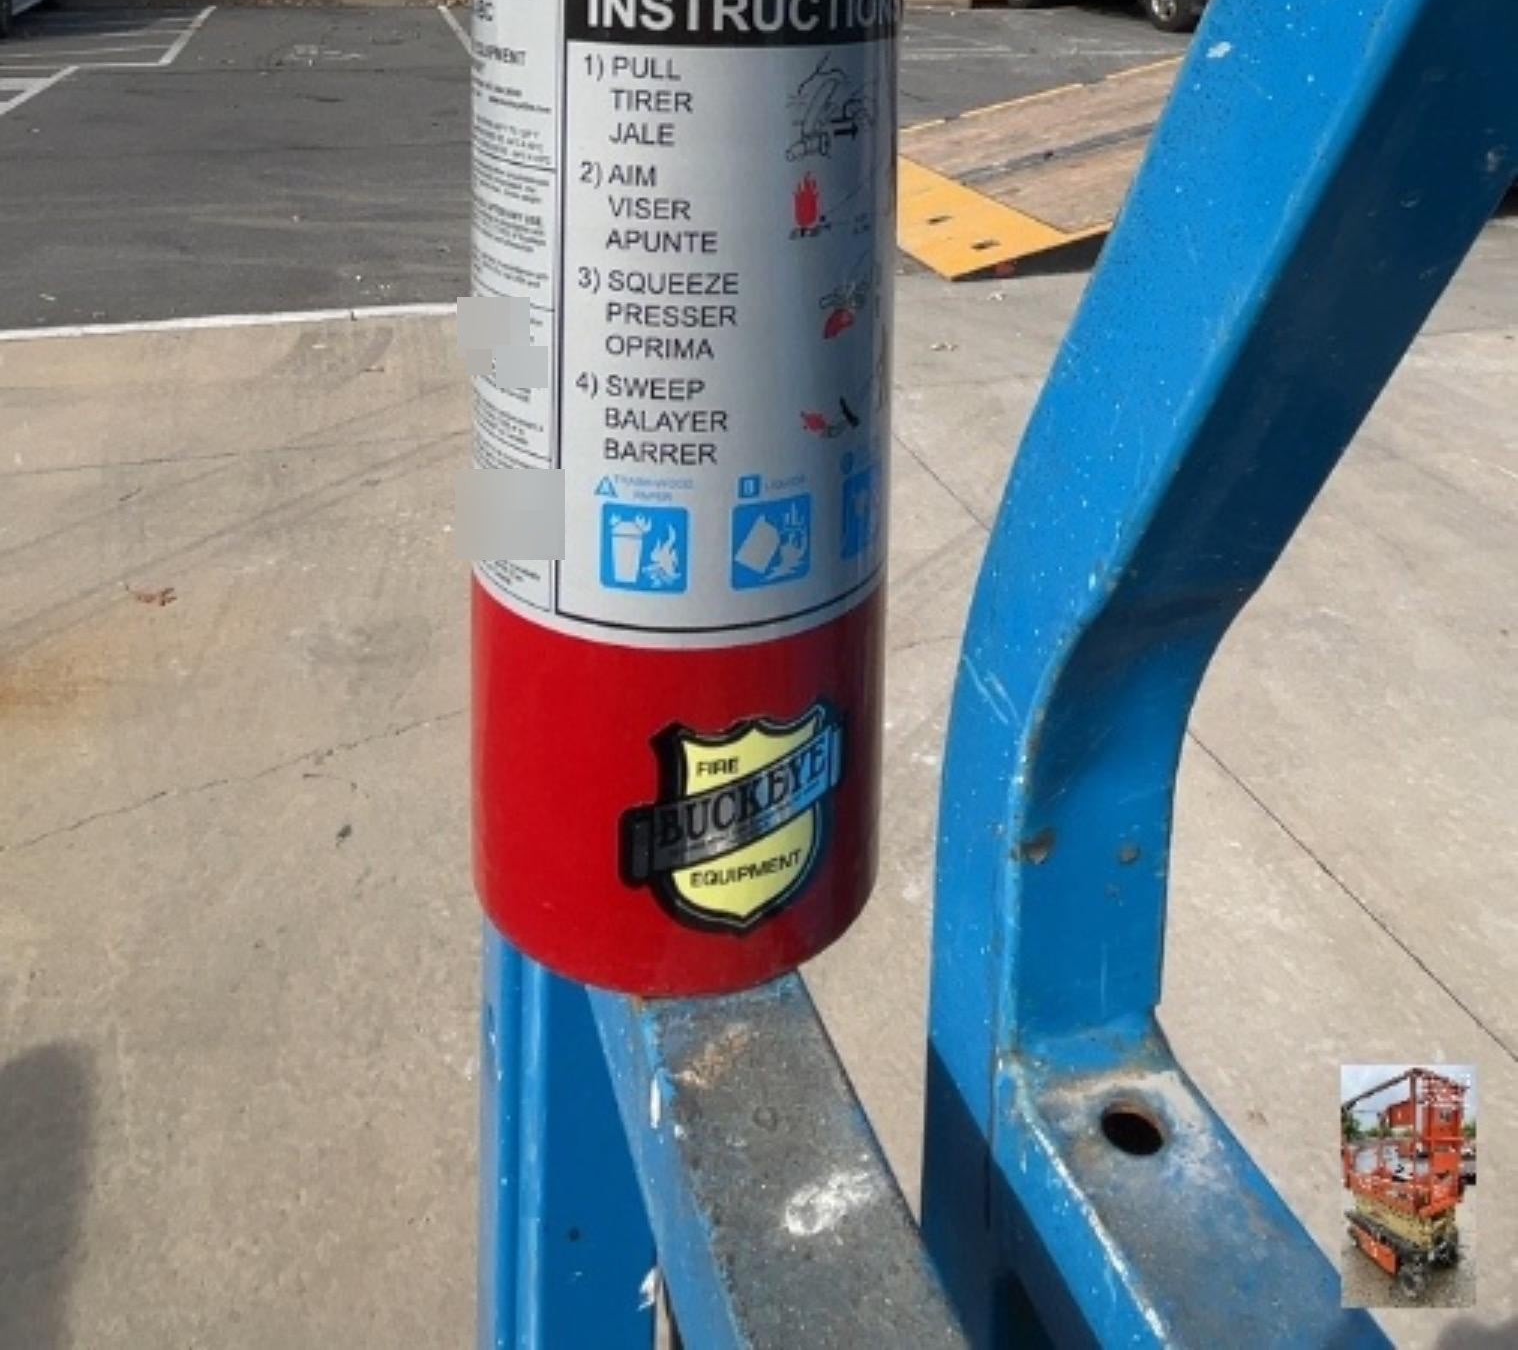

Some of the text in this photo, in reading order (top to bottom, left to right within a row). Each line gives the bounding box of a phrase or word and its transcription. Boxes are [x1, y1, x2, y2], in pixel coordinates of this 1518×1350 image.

[585, 54, 680, 81] 1) PULL
[610, 88, 692, 112] TIRER
[609, 122, 674, 146] JALE
[579, 161, 602, 188] 2)
[608, 164, 656, 187] AIM
[608, 195, 690, 220] VISER
[605, 229, 717, 253] APUNTE
[578, 266, 600, 293] 3)
[608, 270, 738, 294] SQUEEZE
[606, 302, 736, 327] PRESSER
[605, 335, 714, 359] OPRIMA
[576, 372, 705, 400] 4) SWEEP
[605, 407, 727, 432] BALAYER
[604, 438, 717, 465] BARRER
[696, 757, 740, 778] FIRE
[657, 743, 827, 848] BUCKEYE
[690, 851, 802, 888] EQUIPMENT
